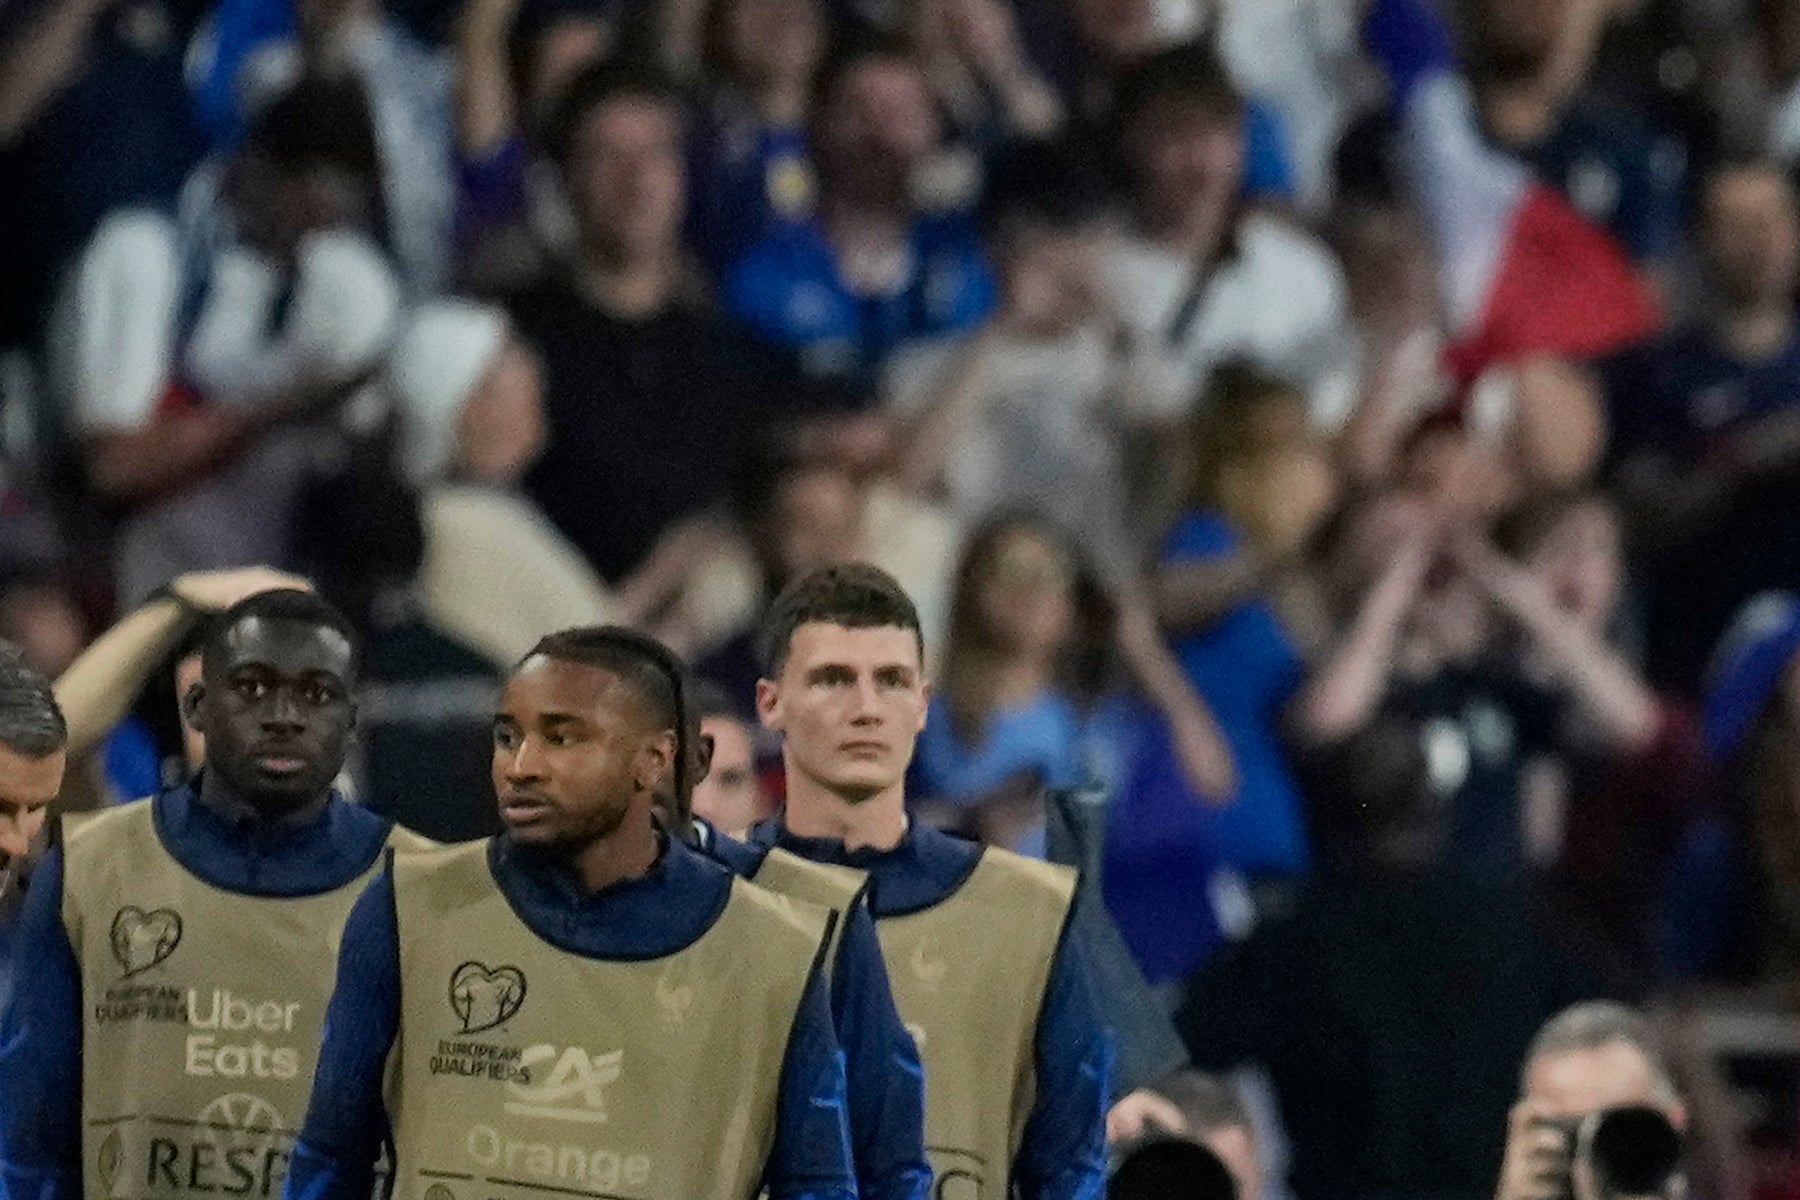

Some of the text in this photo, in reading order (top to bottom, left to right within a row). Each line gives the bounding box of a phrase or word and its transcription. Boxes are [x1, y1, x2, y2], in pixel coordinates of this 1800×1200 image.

[187, 989, 300, 1029] Uber
[185, 1036, 299, 1078] Eats
[467, 1125, 651, 1191] Orange
